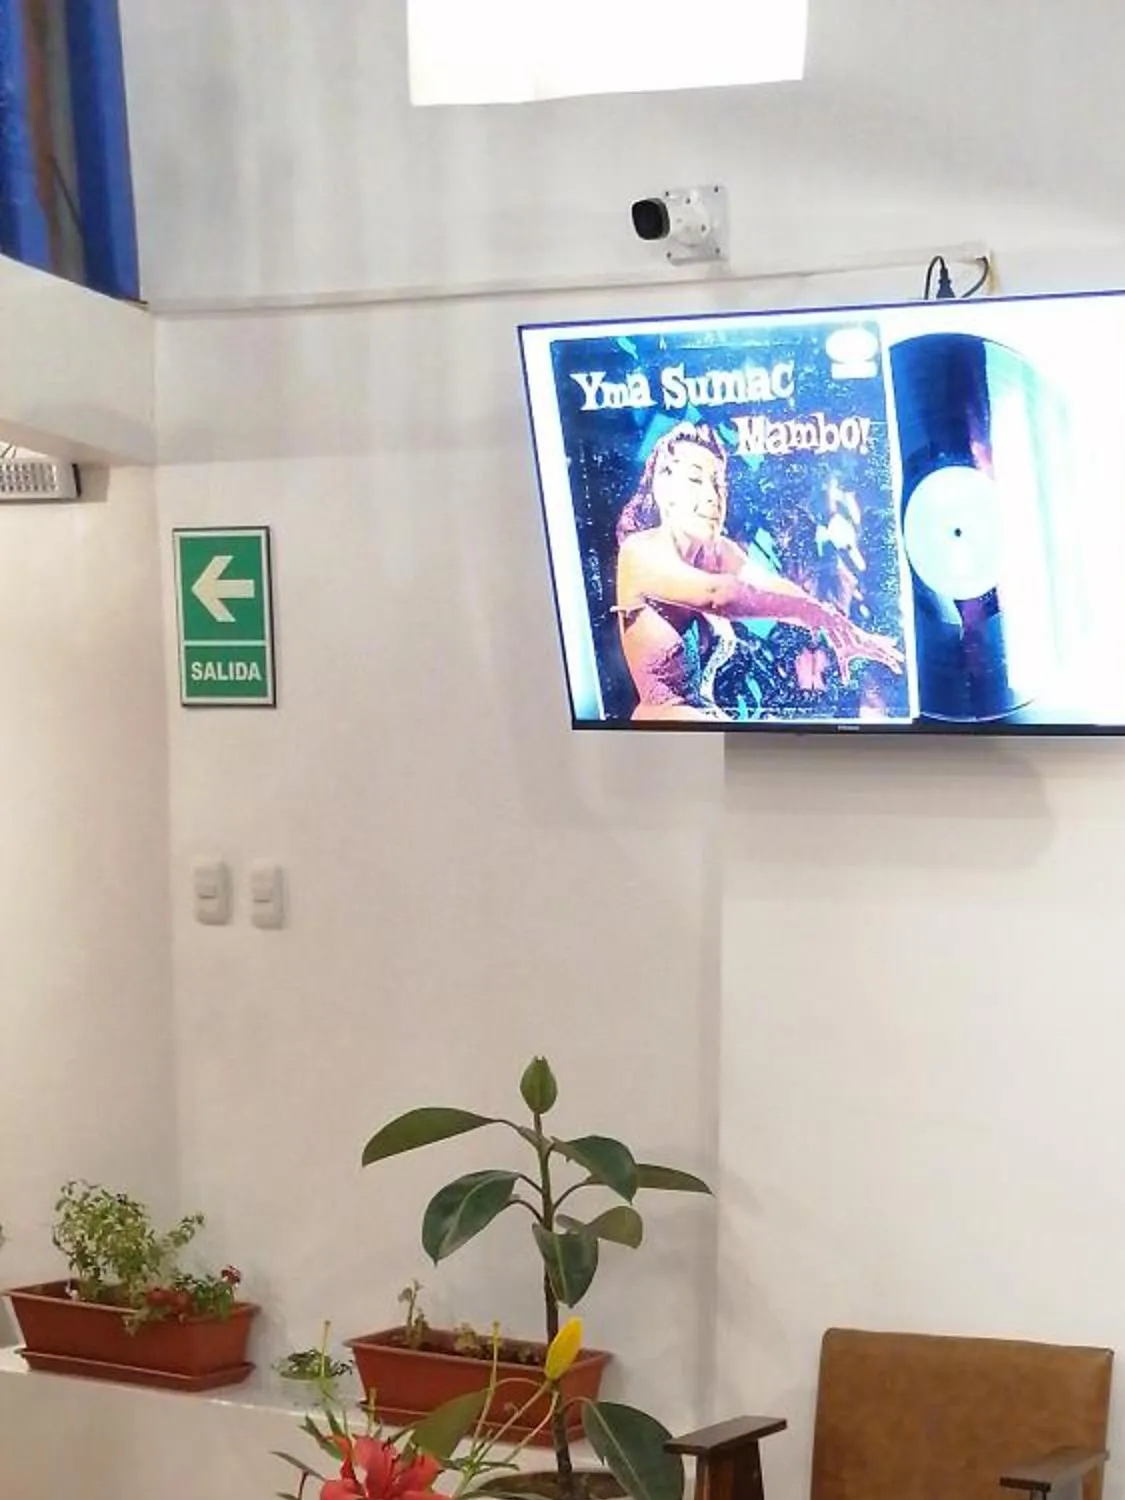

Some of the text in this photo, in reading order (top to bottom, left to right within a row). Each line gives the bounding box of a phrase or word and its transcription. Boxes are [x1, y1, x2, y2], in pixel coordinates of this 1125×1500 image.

[570, 362, 796, 411] Yma Sumac
[730, 411, 871, 455] Mambo!
[191, 661, 262, 681] SALIDA
